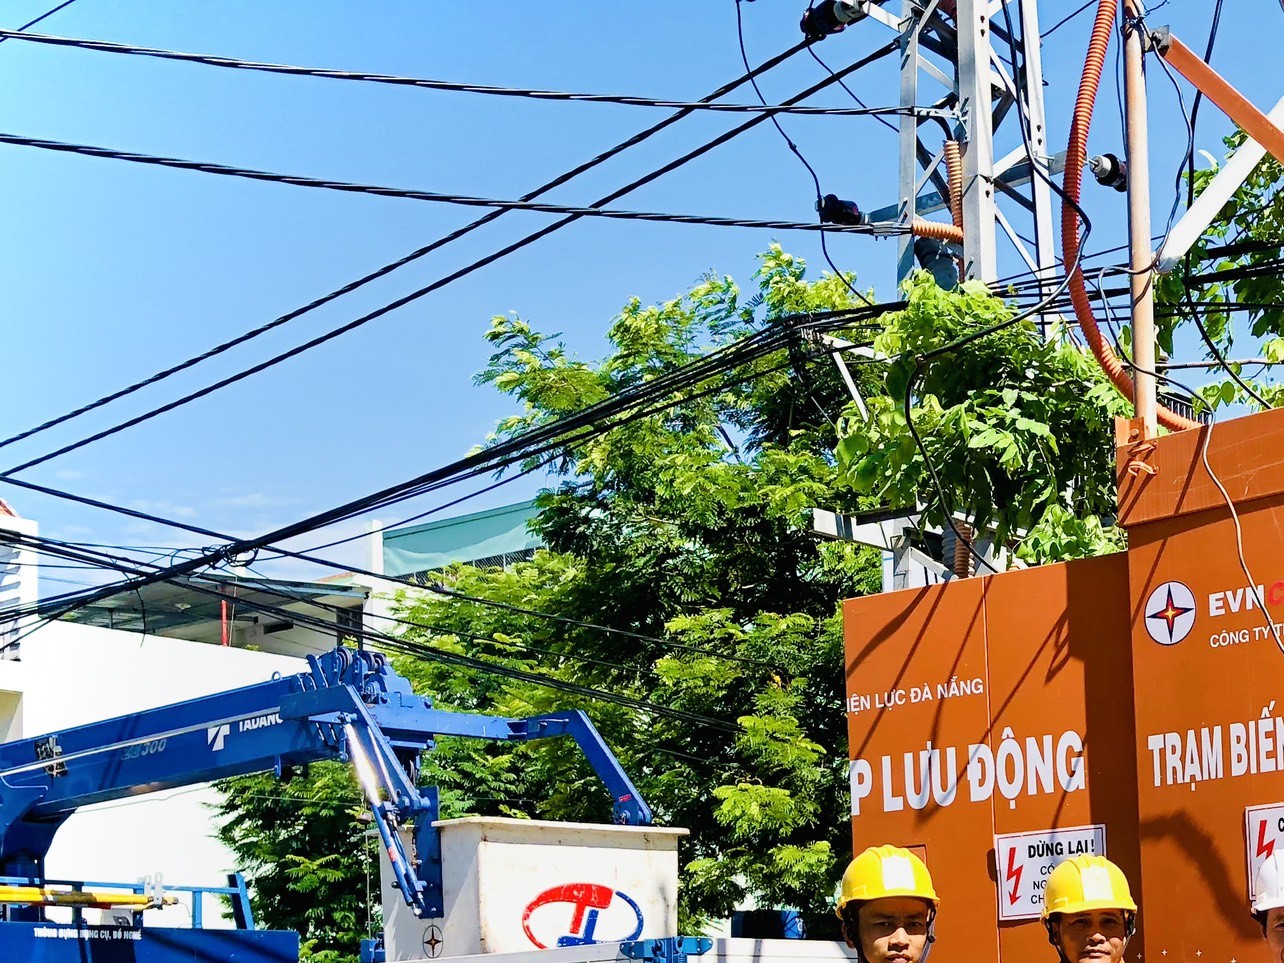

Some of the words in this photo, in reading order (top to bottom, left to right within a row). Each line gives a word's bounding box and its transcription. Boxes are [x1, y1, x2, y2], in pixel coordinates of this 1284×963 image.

[1209, 629, 1250, 649] CÔNG
[1253, 625, 1272, 641] TY
[847, 694, 870, 716] IỆN
[875, 689, 906, 711] LỰC
[910, 682, 933, 703] ĐÀ
[937, 676, 984, 700] NẴNG
[1148, 726, 1223, 791] TRẠM
[850, 758, 872, 816] P
[881, 740, 958, 812] LƯU
[967, 726, 1086, 810] ĐỘNG
[1028, 840, 1063, 859] DỪNG
[1033, 880, 1047, 891] NG
[1031, 895, 1045, 905] CH
